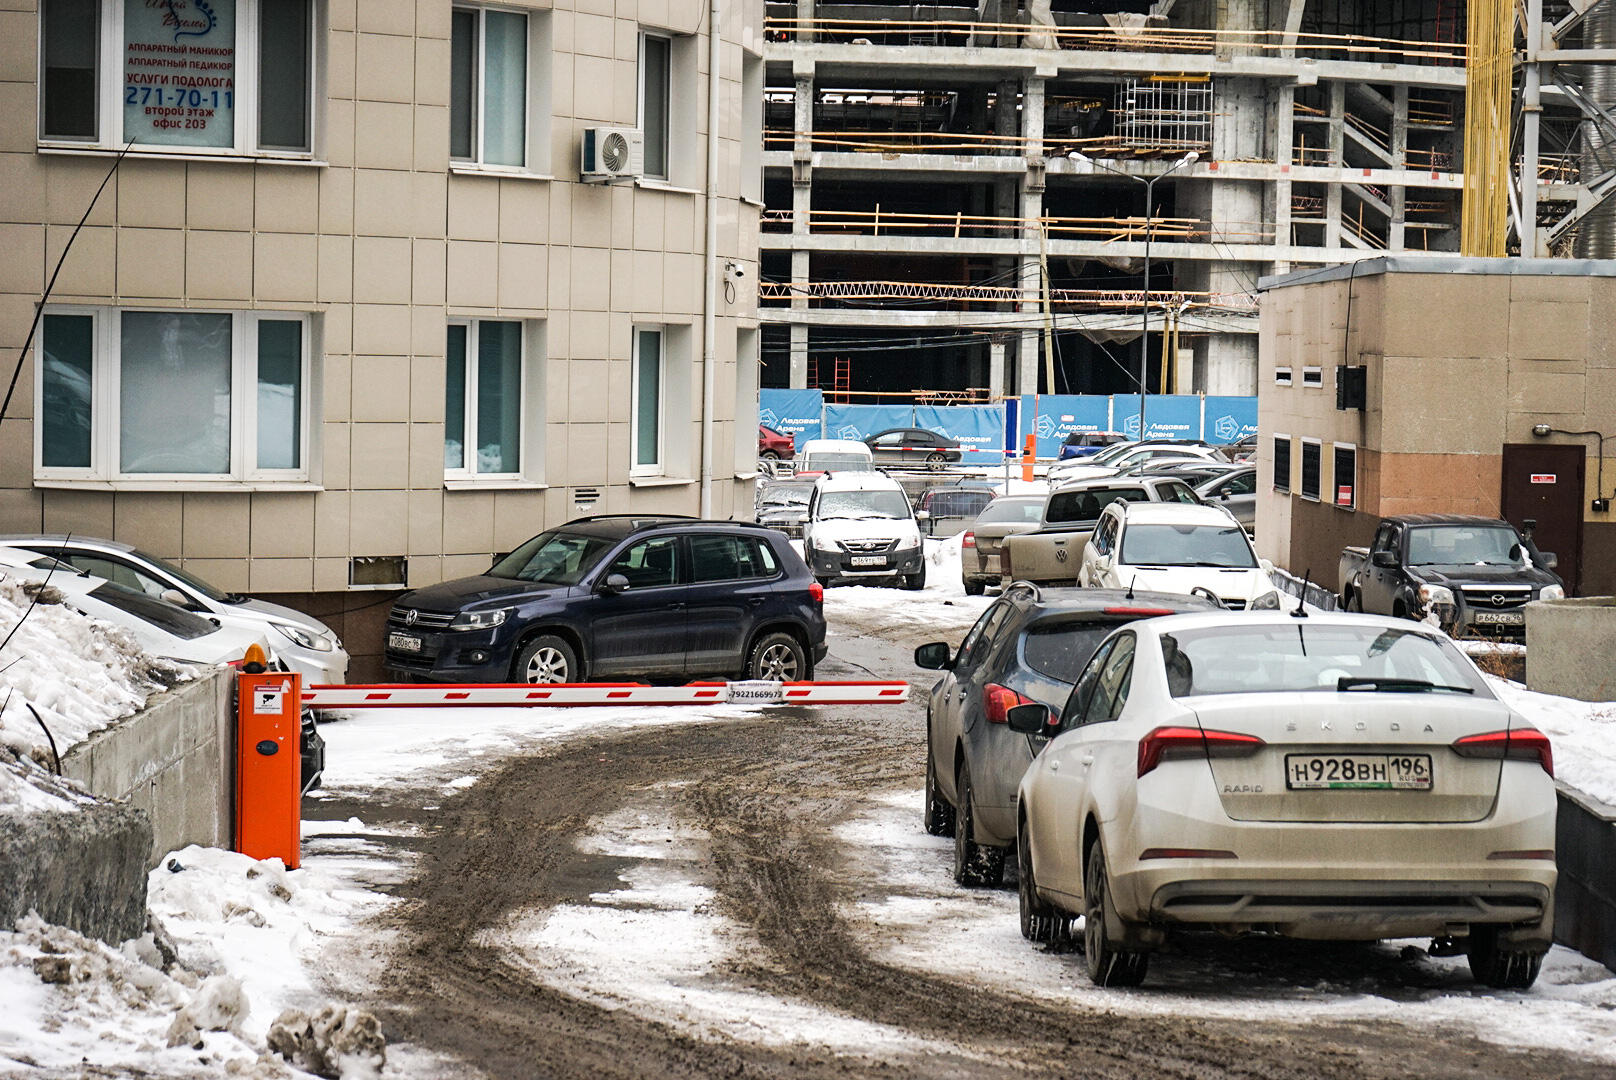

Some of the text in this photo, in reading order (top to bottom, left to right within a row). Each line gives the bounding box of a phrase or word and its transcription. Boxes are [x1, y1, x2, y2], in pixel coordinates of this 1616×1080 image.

[128, 43, 233, 56] АППАРАТНЫЙ МАНИКЮР
[128, 57, 233, 70] АППАРАТНЫЙ ПЕДИКЮР
[127, 73, 233, 88] УСЛУГИ ПОДОЛОГА
[126, 86, 232, 109] 271-70-11
[145, 105, 214, 117] второй этаж
[153, 118, 206, 130] офис 203
[1390, 758, 1425, 776] 196
[1223, 784, 1263, 793] RAPID
